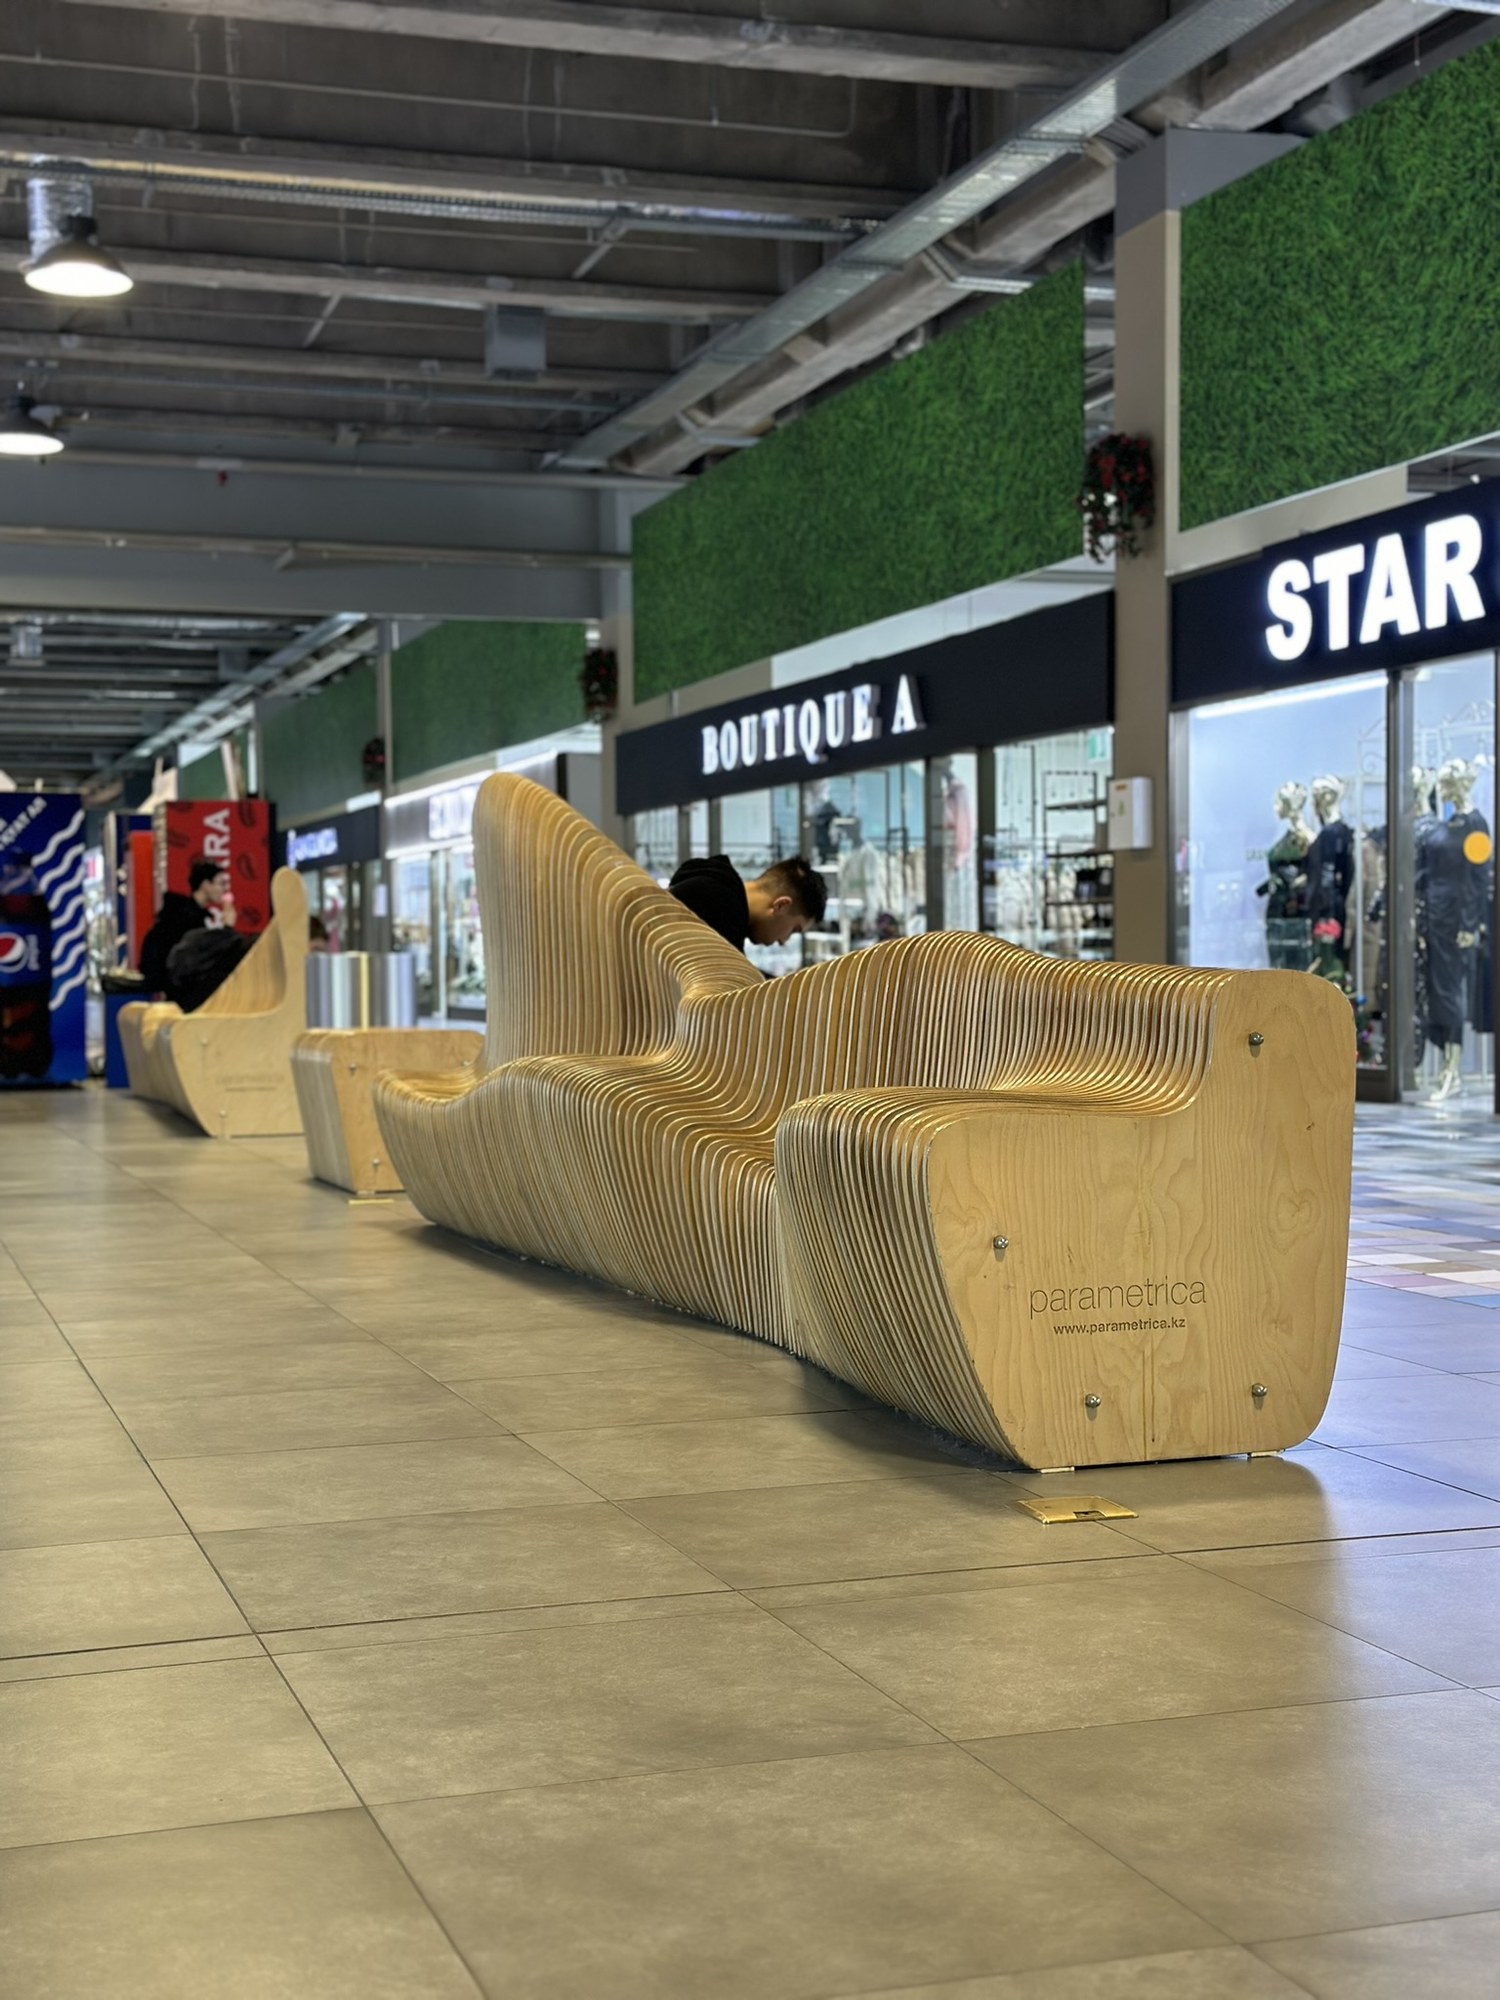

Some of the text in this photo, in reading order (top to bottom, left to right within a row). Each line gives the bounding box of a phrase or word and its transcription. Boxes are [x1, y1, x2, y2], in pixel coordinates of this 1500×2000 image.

[1265, 514, 1486, 661] STAR
[702, 674, 918, 775] BOUTIQUE A
[1030, 1276, 1206, 1320] parametrica
[1053, 1316, 1186, 1335] www.parametrica.kz
